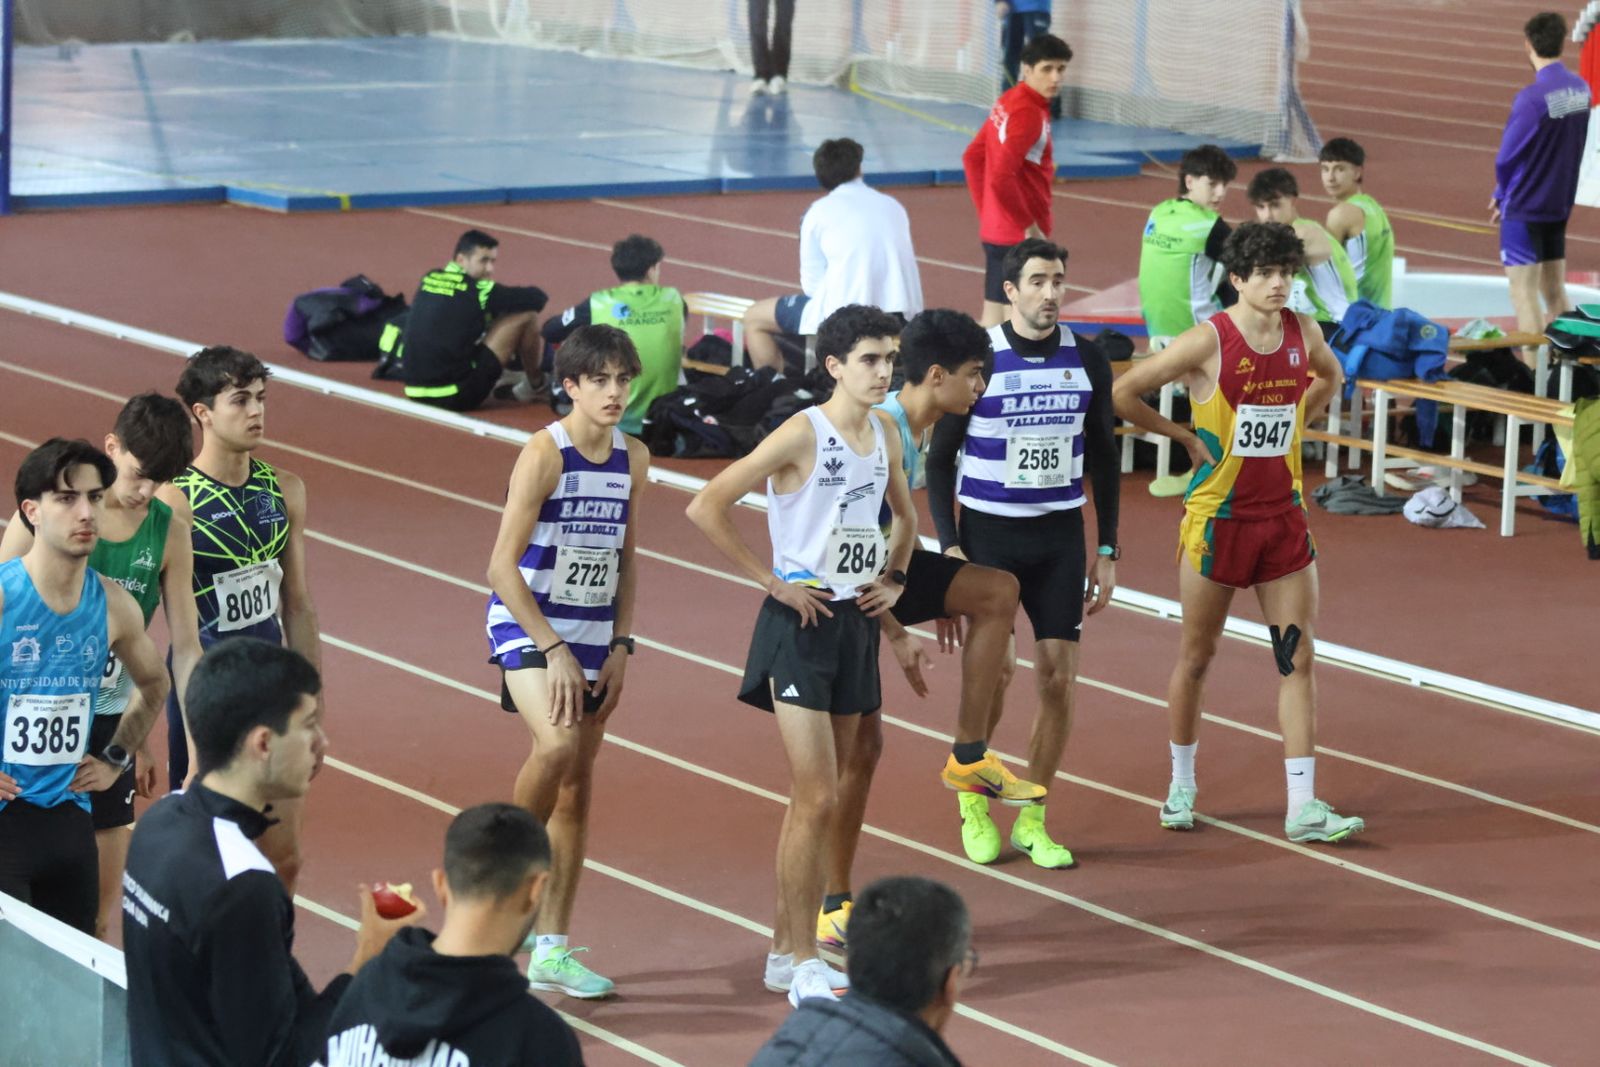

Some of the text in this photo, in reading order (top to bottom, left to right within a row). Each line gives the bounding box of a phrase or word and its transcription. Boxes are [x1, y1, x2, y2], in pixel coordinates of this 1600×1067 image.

[618, 317, 667, 326] ARANDA
[1000, 393, 1081, 415] RACING
[1006, 415, 1075, 428] VALLADOLID
[1238, 421, 1291, 448] 3947
[1018, 448, 1059, 470] 2585
[559, 500, 623, 520] RACING
[565, 562, 609, 587] 2722
[226, 580, 272, 622] 8081
[11, 715, 81, 754] 3385
